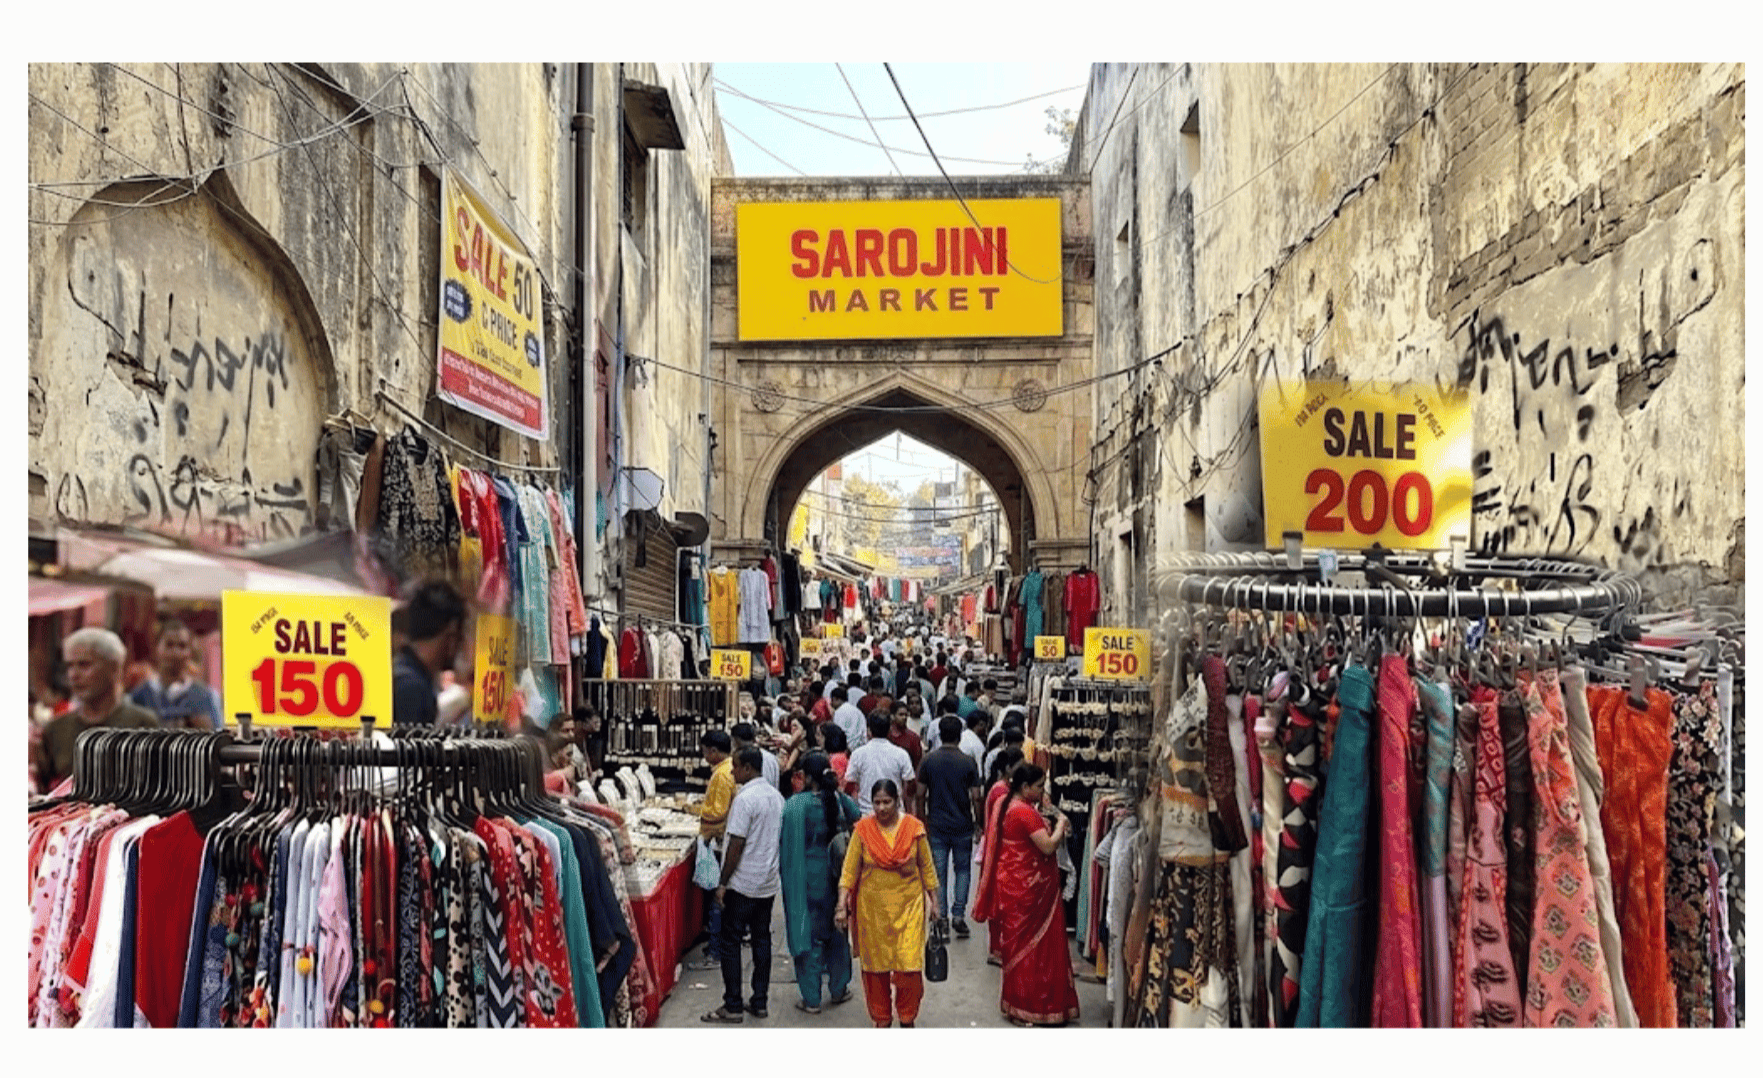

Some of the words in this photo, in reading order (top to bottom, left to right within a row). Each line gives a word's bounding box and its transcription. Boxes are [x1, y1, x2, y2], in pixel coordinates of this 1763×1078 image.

[453, 206, 508, 302] SALE
[513, 260, 533, 321] 50
[791, 227, 1007, 278] SAROJINI
[809, 287, 1000, 312] MARKET
[1324, 407, 1416, 460] SALE
[1304, 467, 1433, 537] 200
[274, 618, 347, 656] SALE
[488, 635, 507, 667] SALE
[1102, 635, 1134, 650] SALE
[1096, 652, 1138, 675] 150
[252, 658, 364, 717] 150
[483, 670, 505, 714] 150
